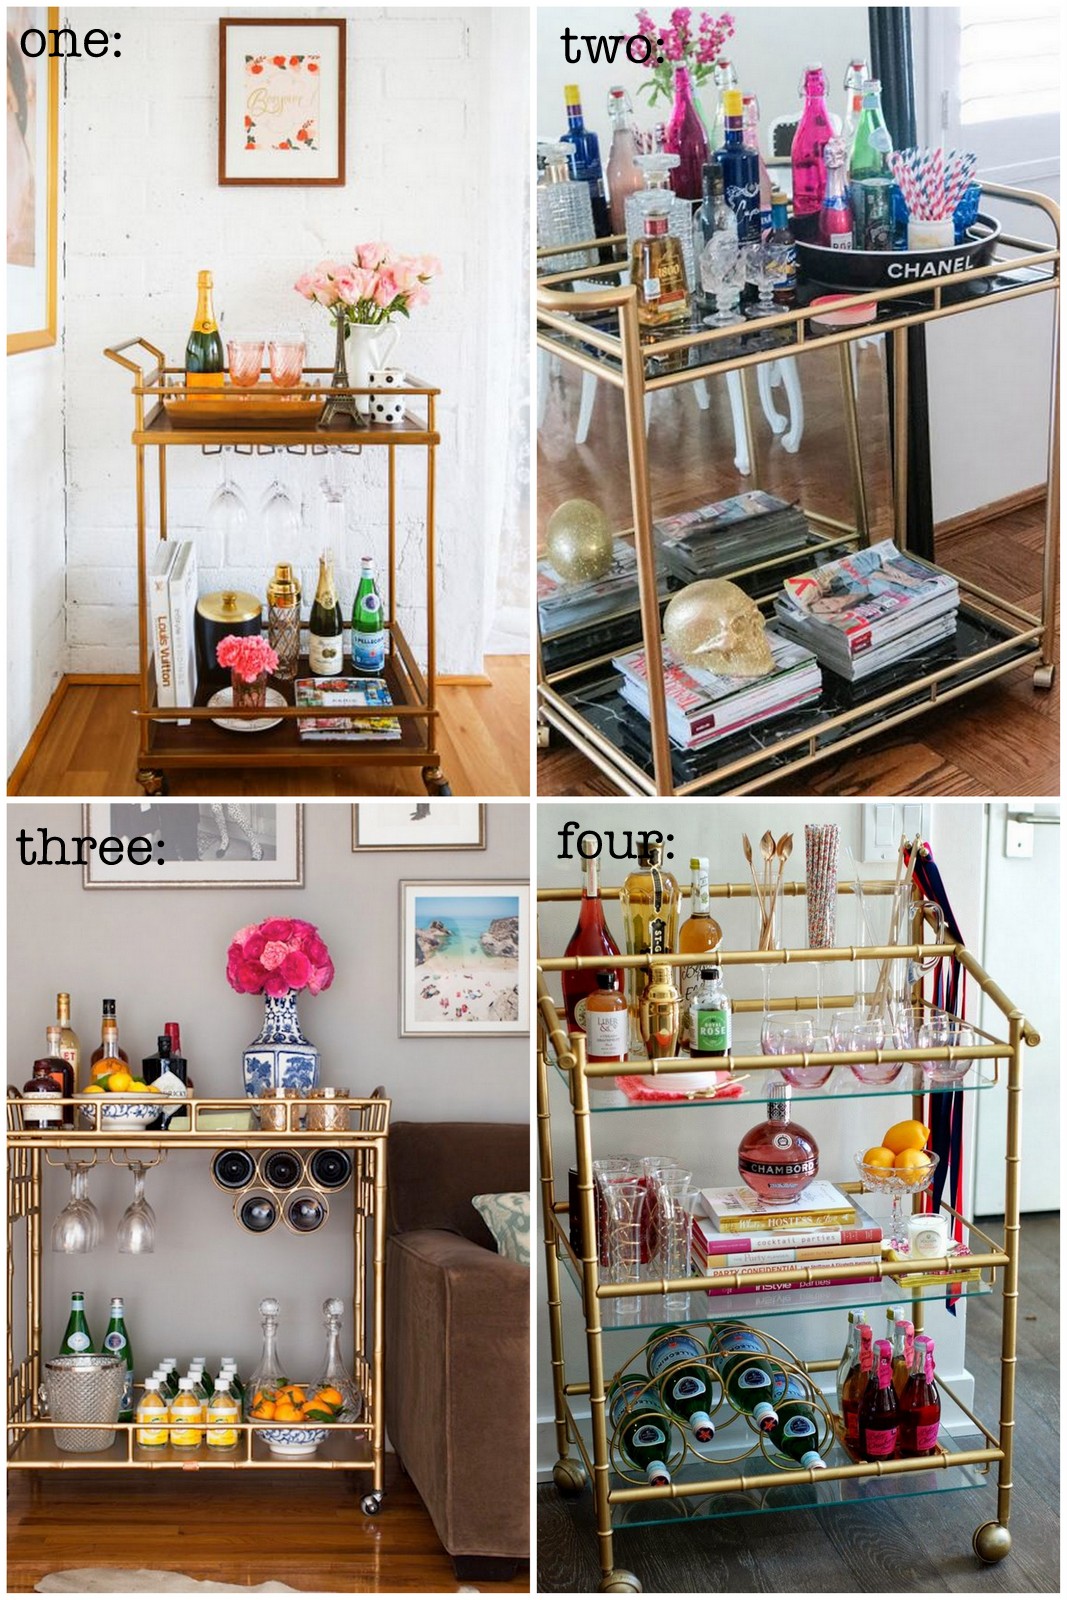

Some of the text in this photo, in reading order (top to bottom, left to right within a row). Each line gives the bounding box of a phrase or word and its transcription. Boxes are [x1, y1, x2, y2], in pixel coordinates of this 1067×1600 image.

[658, 263, 680, 278] 1800
[887, 255, 974, 279] CHANEL
[158, 614, 172, 688] Louis Vuitton
[700, 1026, 727, 1036] ROSE
[751, 1161, 815, 1175] CHAMBORD
[768, 1215, 813, 1228] HOSTESS
[757, 1236, 796, 1247] cocktail
[801, 1234, 836, 1244] parties
[744, 1251, 766, 1263] Party
[741, 1264, 798, 1275] CONFIDENTIAL
